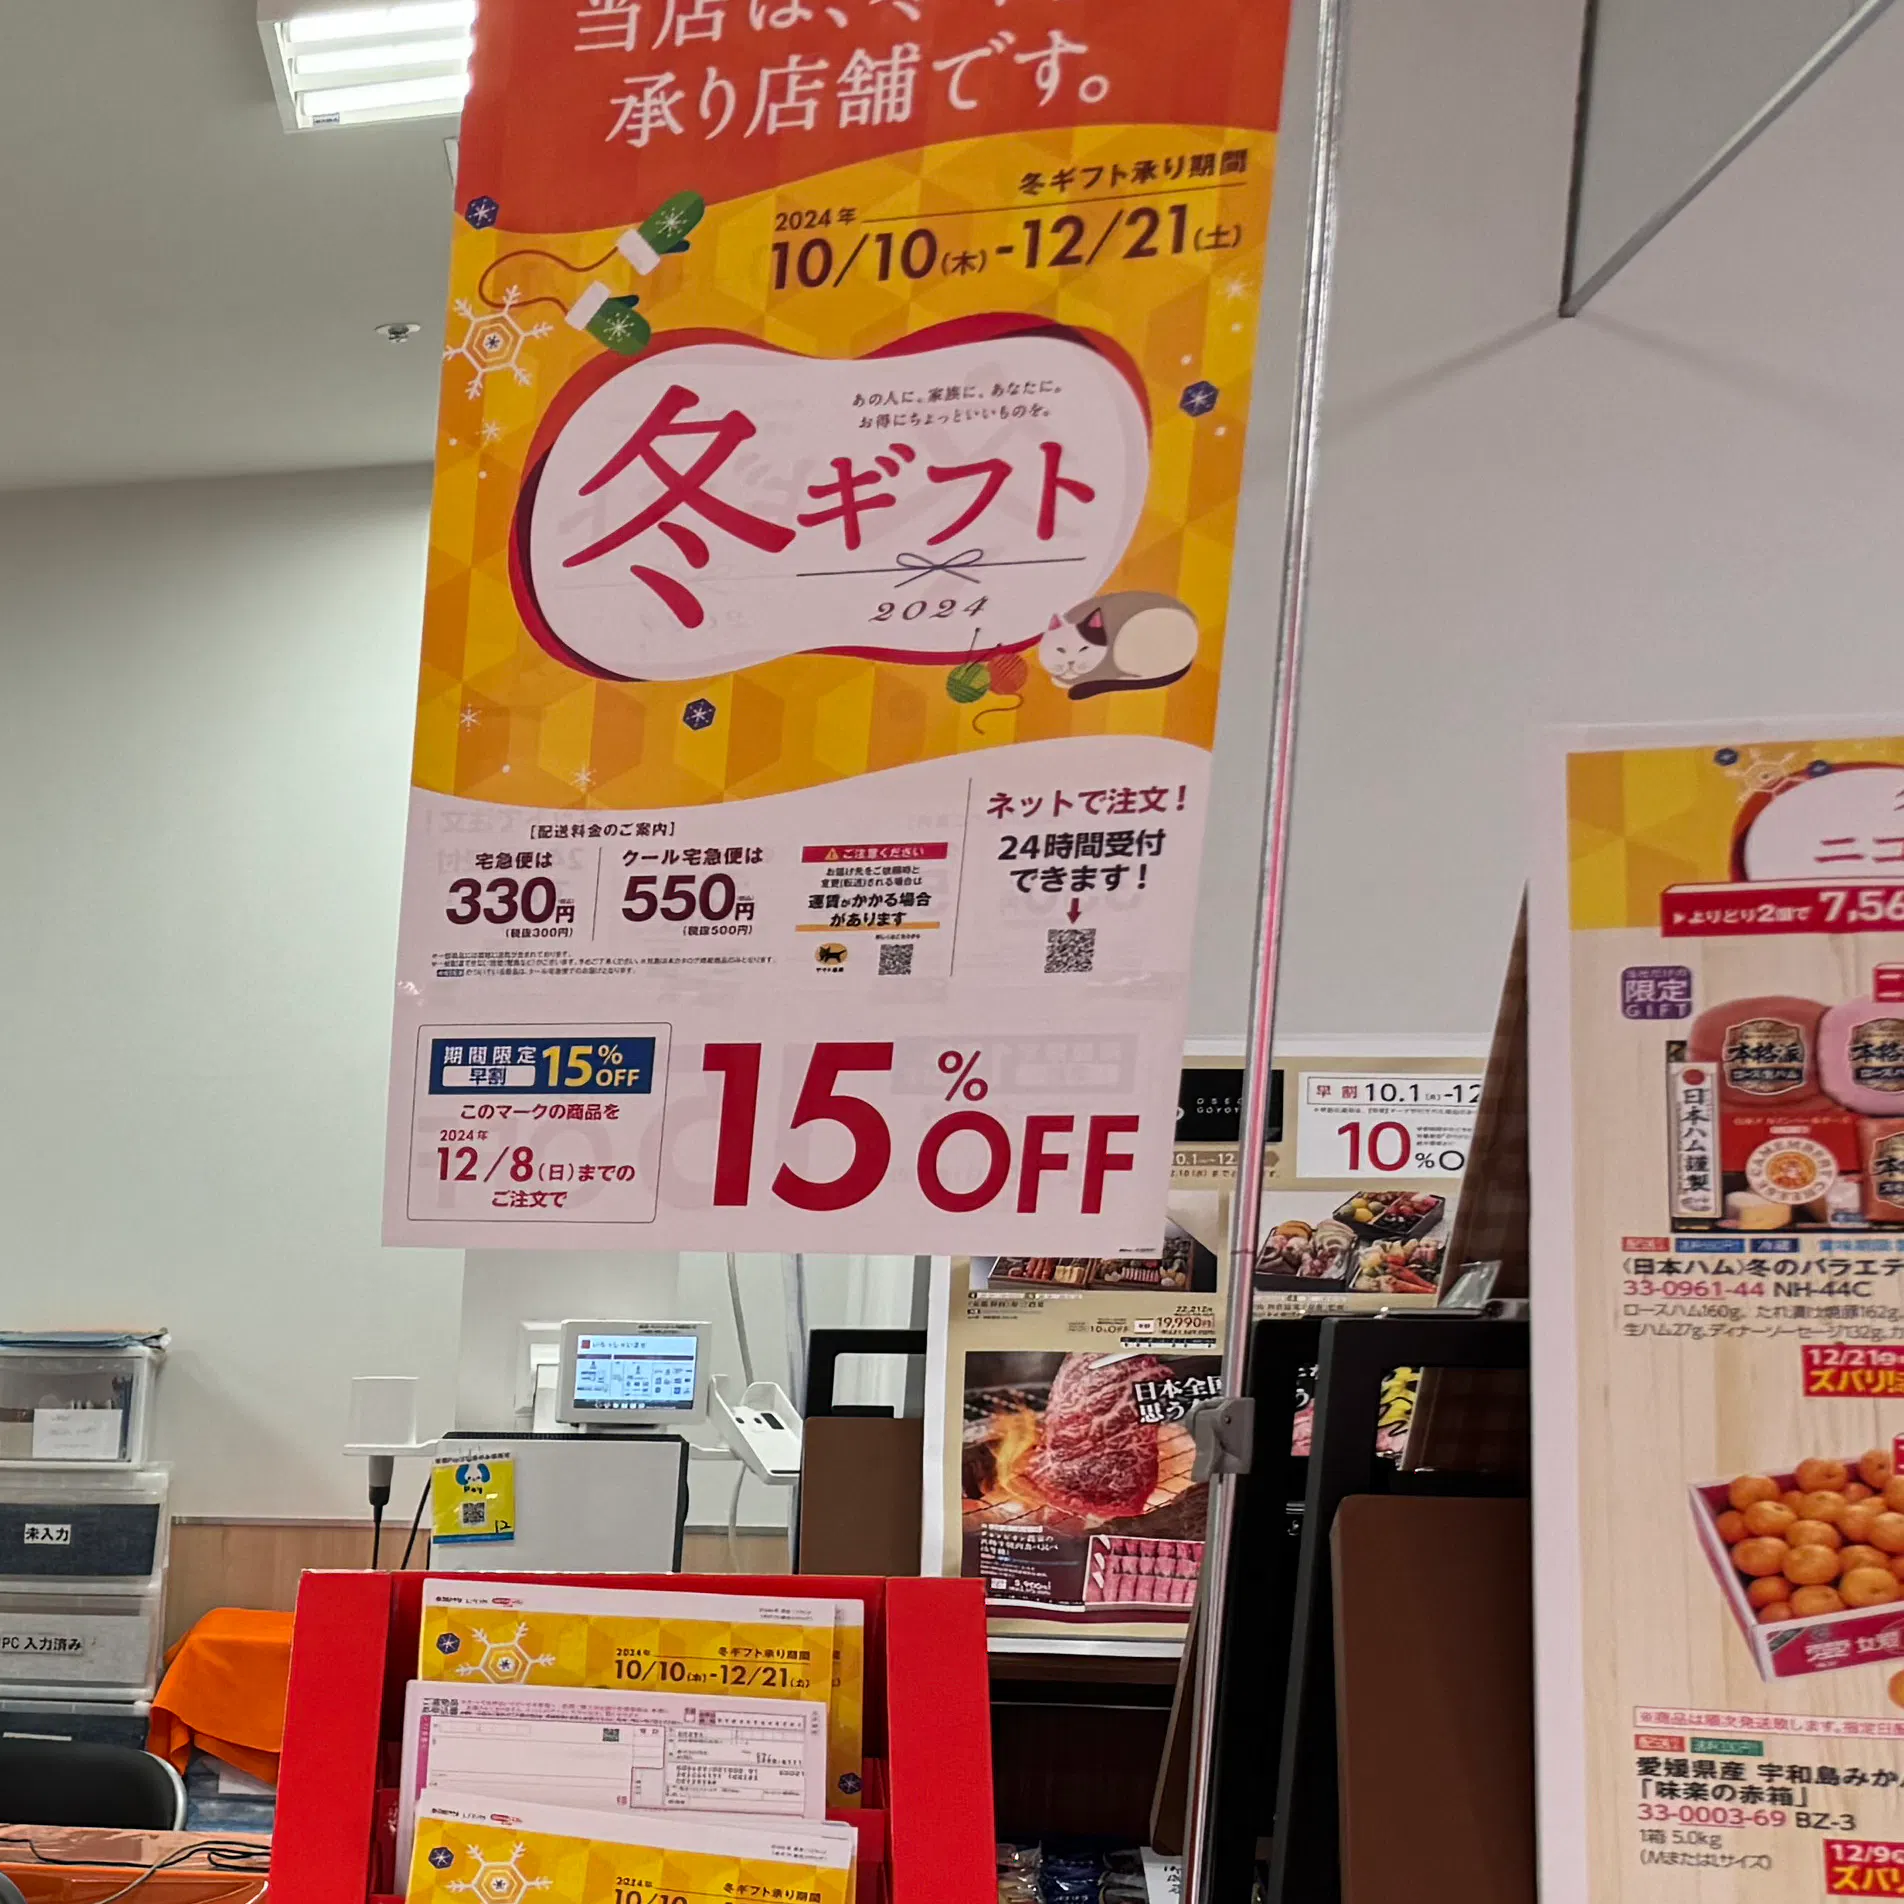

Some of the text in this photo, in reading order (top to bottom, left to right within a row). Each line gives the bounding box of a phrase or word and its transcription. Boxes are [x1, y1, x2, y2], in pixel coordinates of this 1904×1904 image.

[605, 29, 1111, 148] 承り店舗です。
[1020, 147, 1247, 196] 冬ギフト承り期間
[775, 206, 858, 230] 2024年
[562, 384, 1096, 630] 冬ギフト
[868, 596, 989, 623] 2024
[621, 845, 764, 868] クール宅急便は
[842, 847, 924, 859] ご注意ください
[998, 829, 1167, 863] 24時間受付
[474, 849, 554, 871] 宅急便は
[447, 875, 575, 926] 330円
[621, 873, 756, 924] 550円
[808, 892, 932, 909] 運賃がかかる場合
[829, 911, 907, 927] があります
[1625, 980, 1691, 1002] 限定
[1625, 1004, 1687, 1017] GIFT
[443, 1045, 537, 1067] 期間限定
[541, 1046, 593, 1088] 15
[595, 1066, 640, 1088] OFF
[468, 1066, 506, 1087] 早割
[460, 1102, 620, 1121] このマークの商品を
[439, 1128, 488, 1143] 2024年
[702, 1042, 894, 1211] 15
[917, 1110, 1140, 1214] OFF
[1338, 1121, 1411, 1171] 10
[1680, 1088, 1710, 1192] 日本ハム謹製
[491, 1190, 568, 1210] ご注文で
[1623, 1280, 1872, 1297] 33-0961-44 NH-44C
[1140, 1402, 1187, 1423] 思う
[25, 1527, 69, 1542] 未入力
[2, 1636, 81, 1652] PC 入力済み
[1637, 1757, 1747, 1782] 愛媛県産
[1638, 1804, 1856, 1831] 33-0003-69 BZ-3
